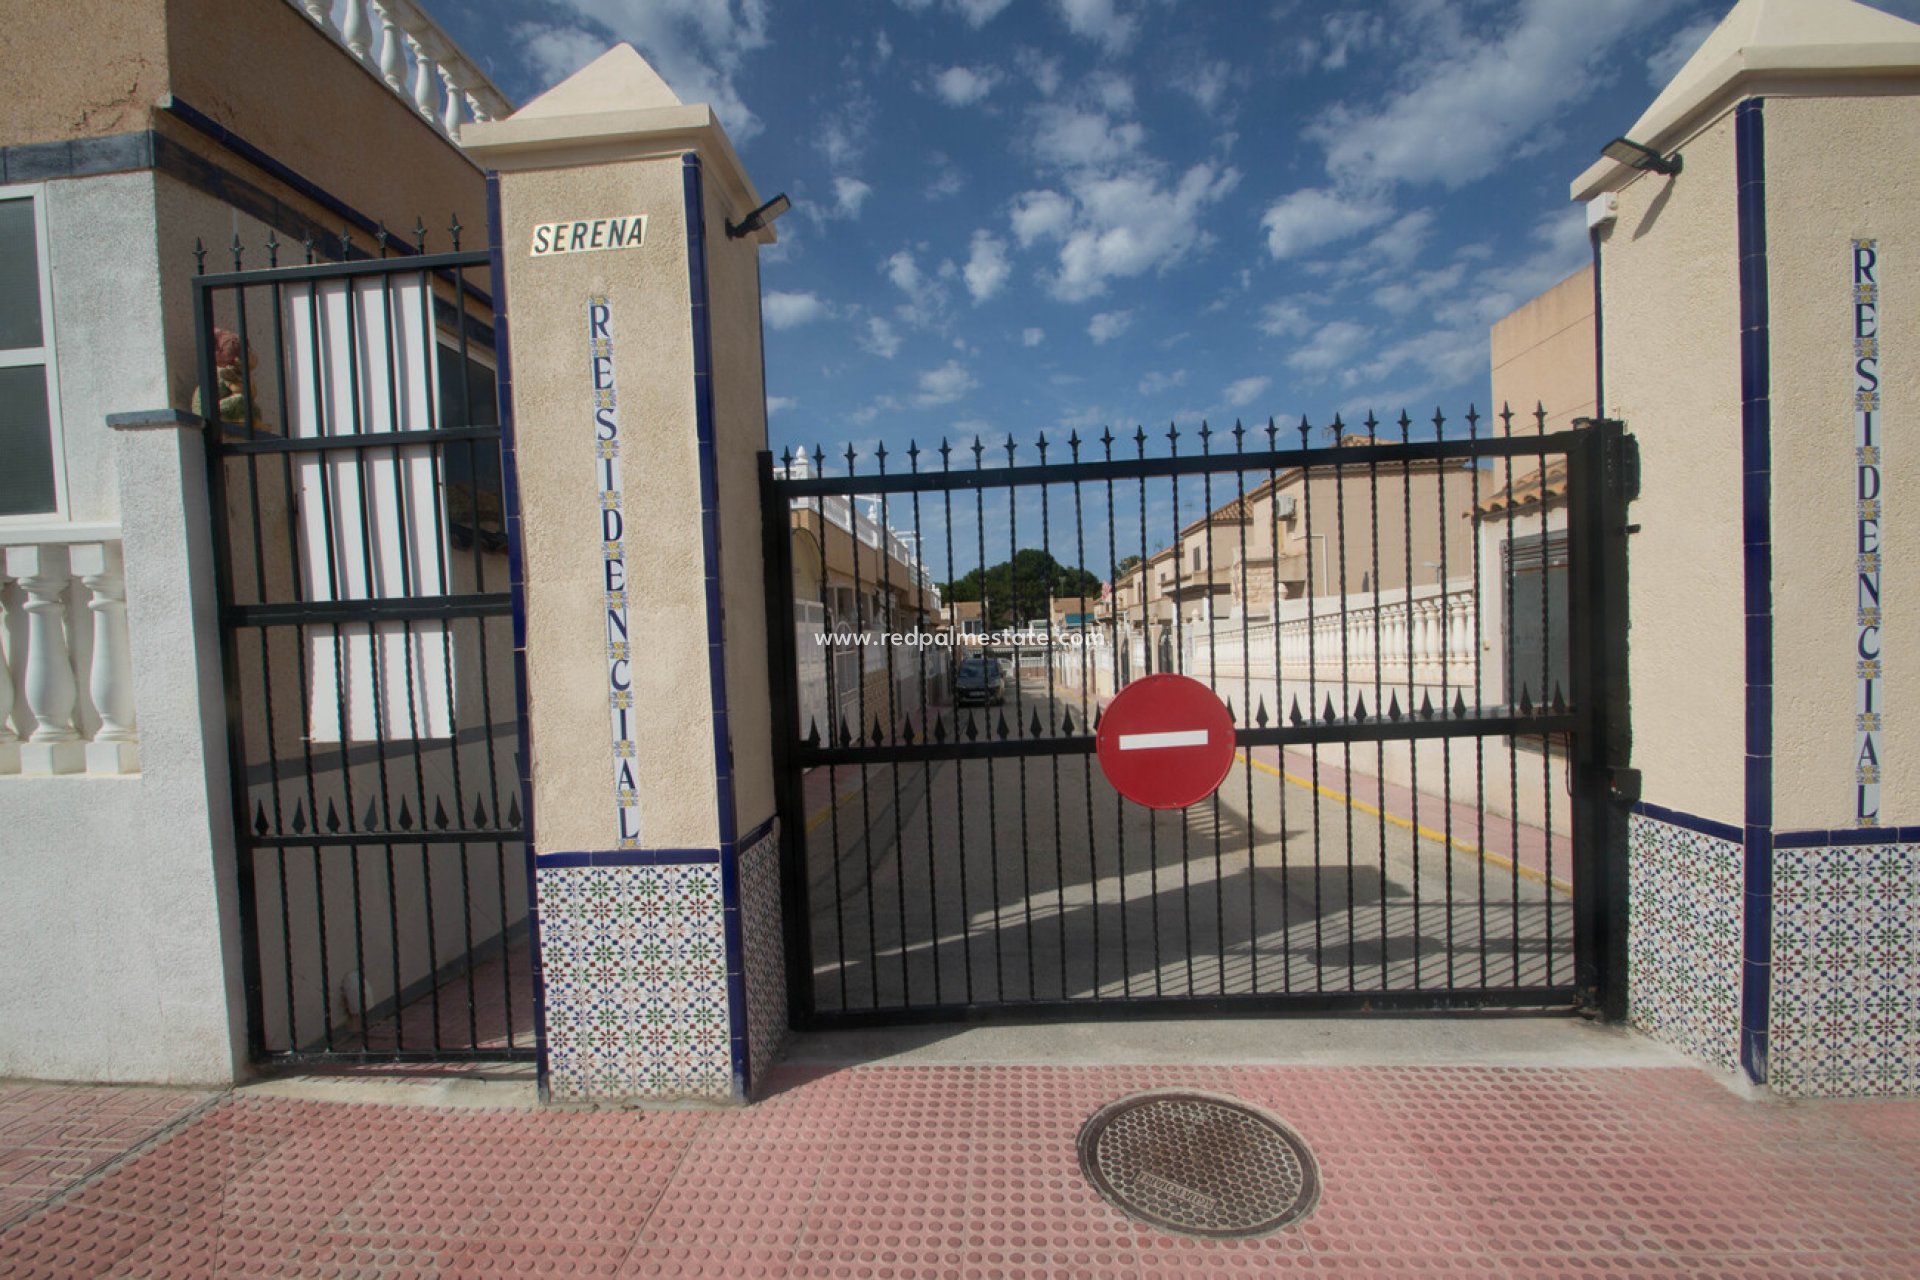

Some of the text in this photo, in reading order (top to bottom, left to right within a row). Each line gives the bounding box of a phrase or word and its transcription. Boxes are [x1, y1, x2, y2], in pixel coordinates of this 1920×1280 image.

[534, 217, 643, 254] SERENA
[590, 305, 640, 839] RESIDENCIAL
[1854, 248, 1880, 818] RESIDENCIAL
